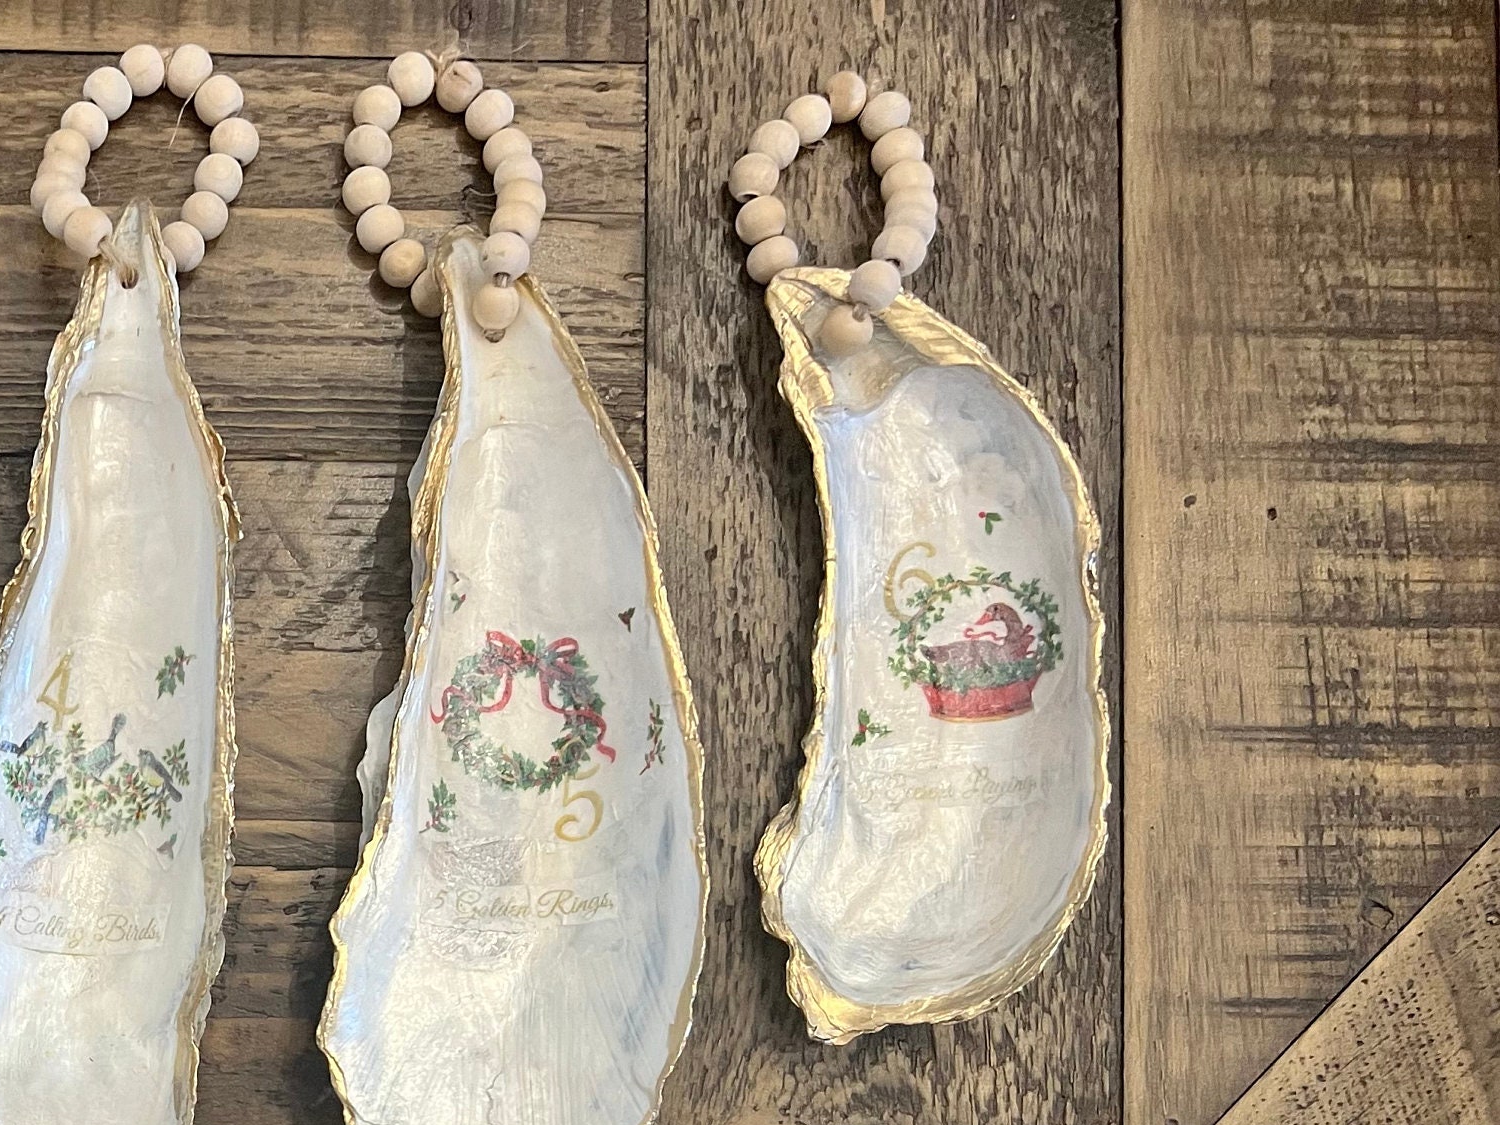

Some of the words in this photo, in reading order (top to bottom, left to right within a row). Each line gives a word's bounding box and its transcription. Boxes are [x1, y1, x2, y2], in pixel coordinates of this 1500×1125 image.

[883, 541, 937, 622] 6
[36, 649, 79, 731] 4
[554, 763, 605, 842] 5
[15, 905, 85, 948] Calling
[453, 889, 531, 924] Golden
